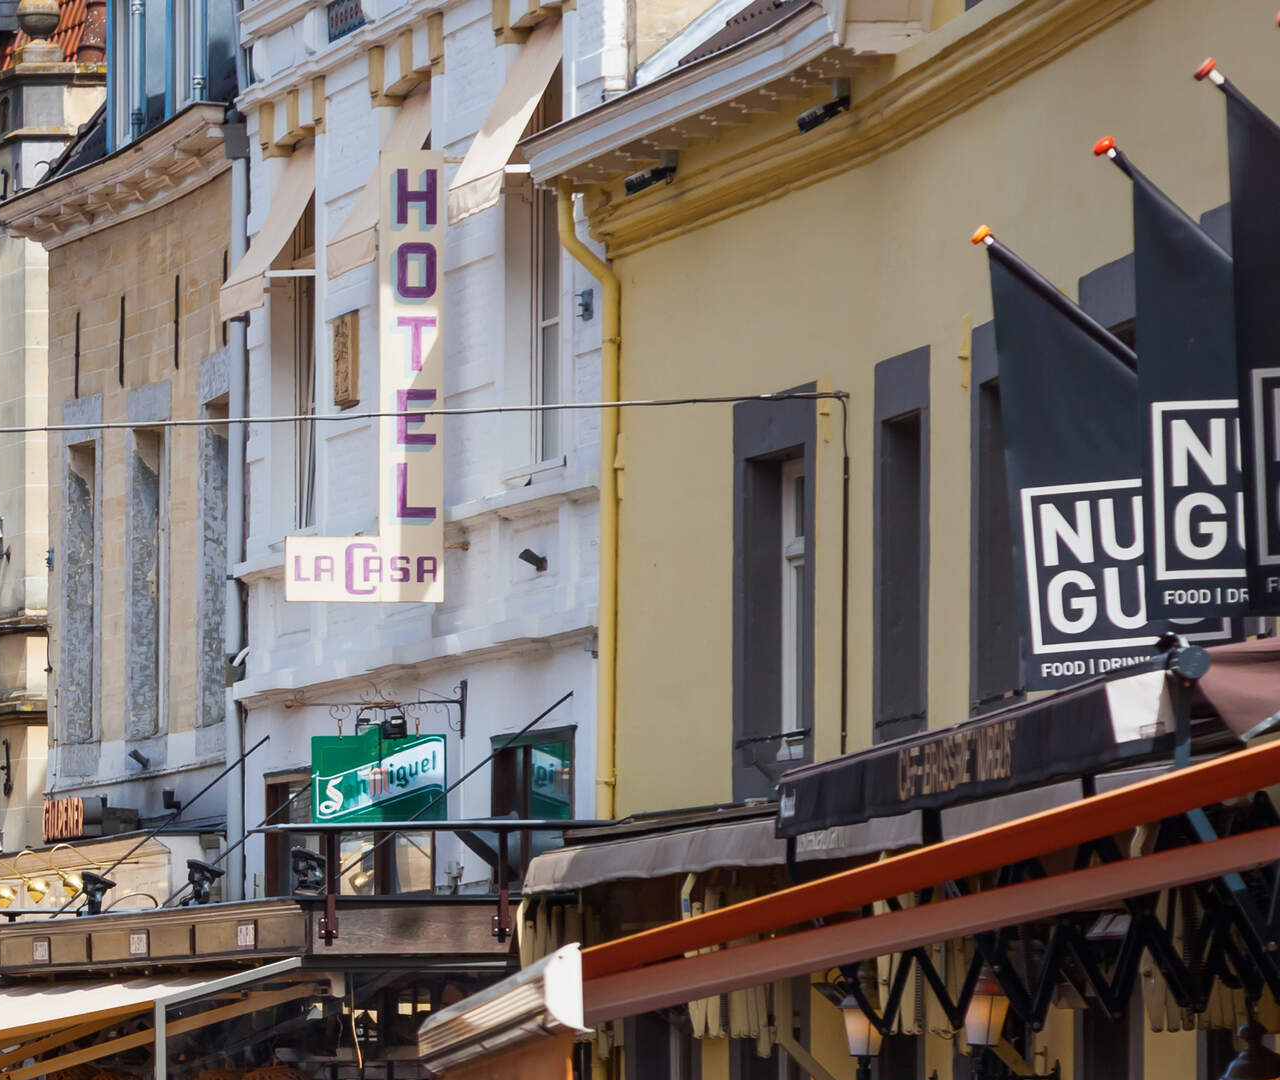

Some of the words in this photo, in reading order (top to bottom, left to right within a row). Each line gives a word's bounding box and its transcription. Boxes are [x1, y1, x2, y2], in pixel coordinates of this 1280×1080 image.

[394, 168, 438, 521] HOTEL
[1171, 418, 1242, 487] N
[1174, 491, 1247, 560] G
[293, 555, 335, 582] LA
[345, 543, 438, 595] CASA
[1047, 564, 1148, 634] GU
[1163, 588, 1211, 605] FOOD
[1227, 588, 1249, 604] DR
[1041, 660, 1085, 678] FOOD
[365, 749, 437, 797] Miguel
